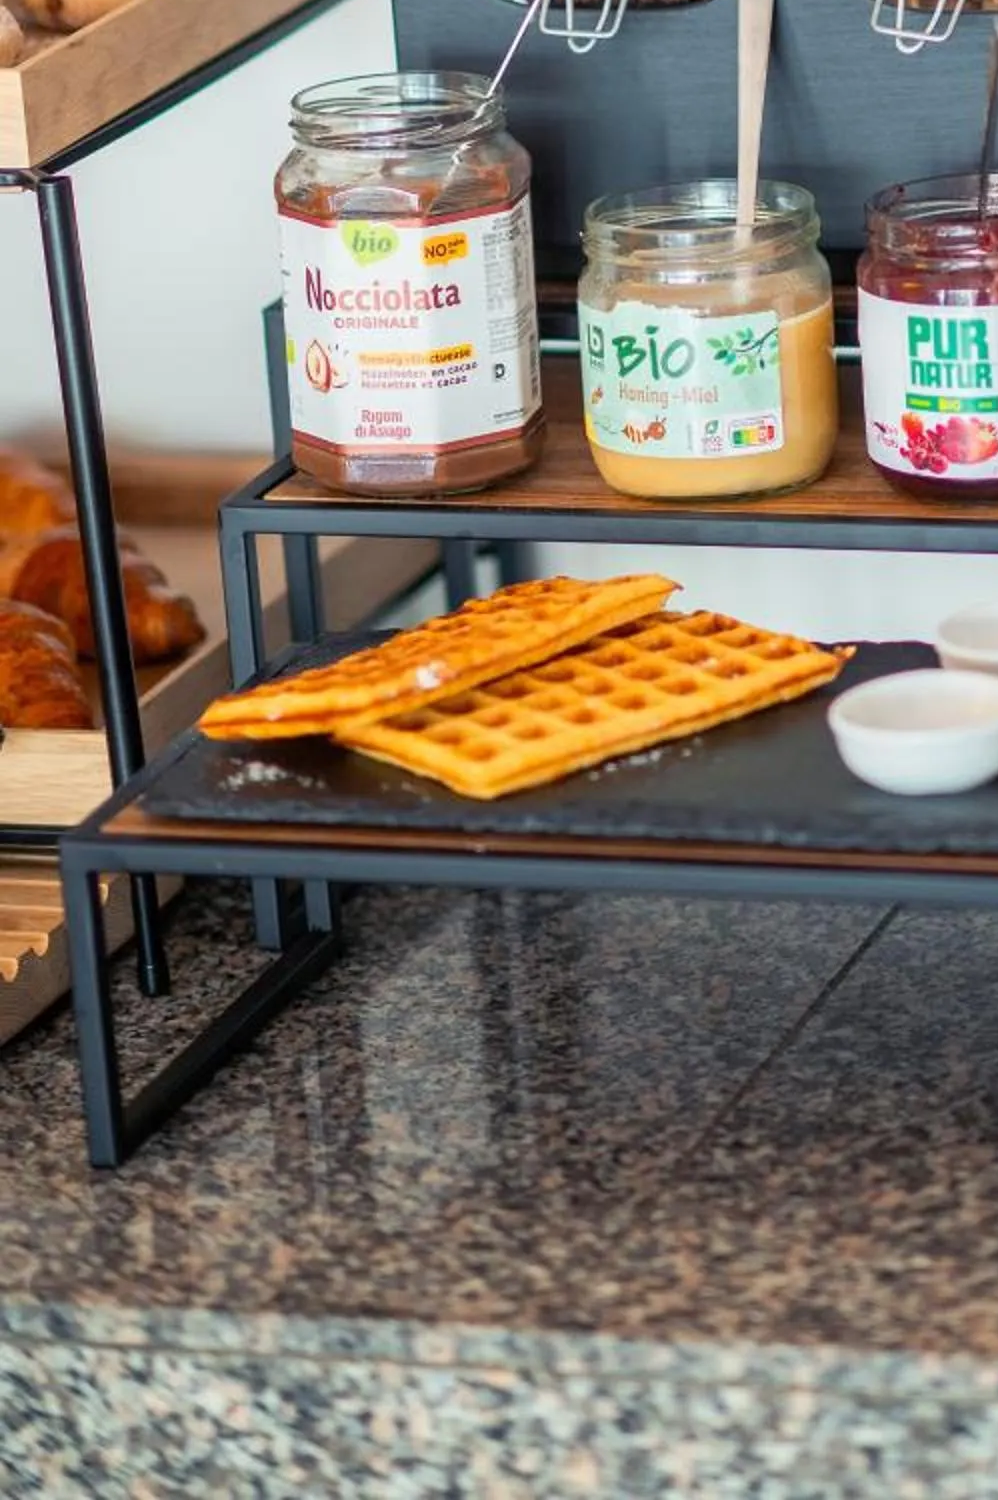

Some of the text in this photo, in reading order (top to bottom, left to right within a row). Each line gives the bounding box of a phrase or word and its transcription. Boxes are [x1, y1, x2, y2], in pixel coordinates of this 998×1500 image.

[305, 266, 462, 312] Nocciolata
[333, 316, 420, 330] ORIGINALE
[907, 316, 990, 360] PUR
[909, 359, 993, 389] NATUR
